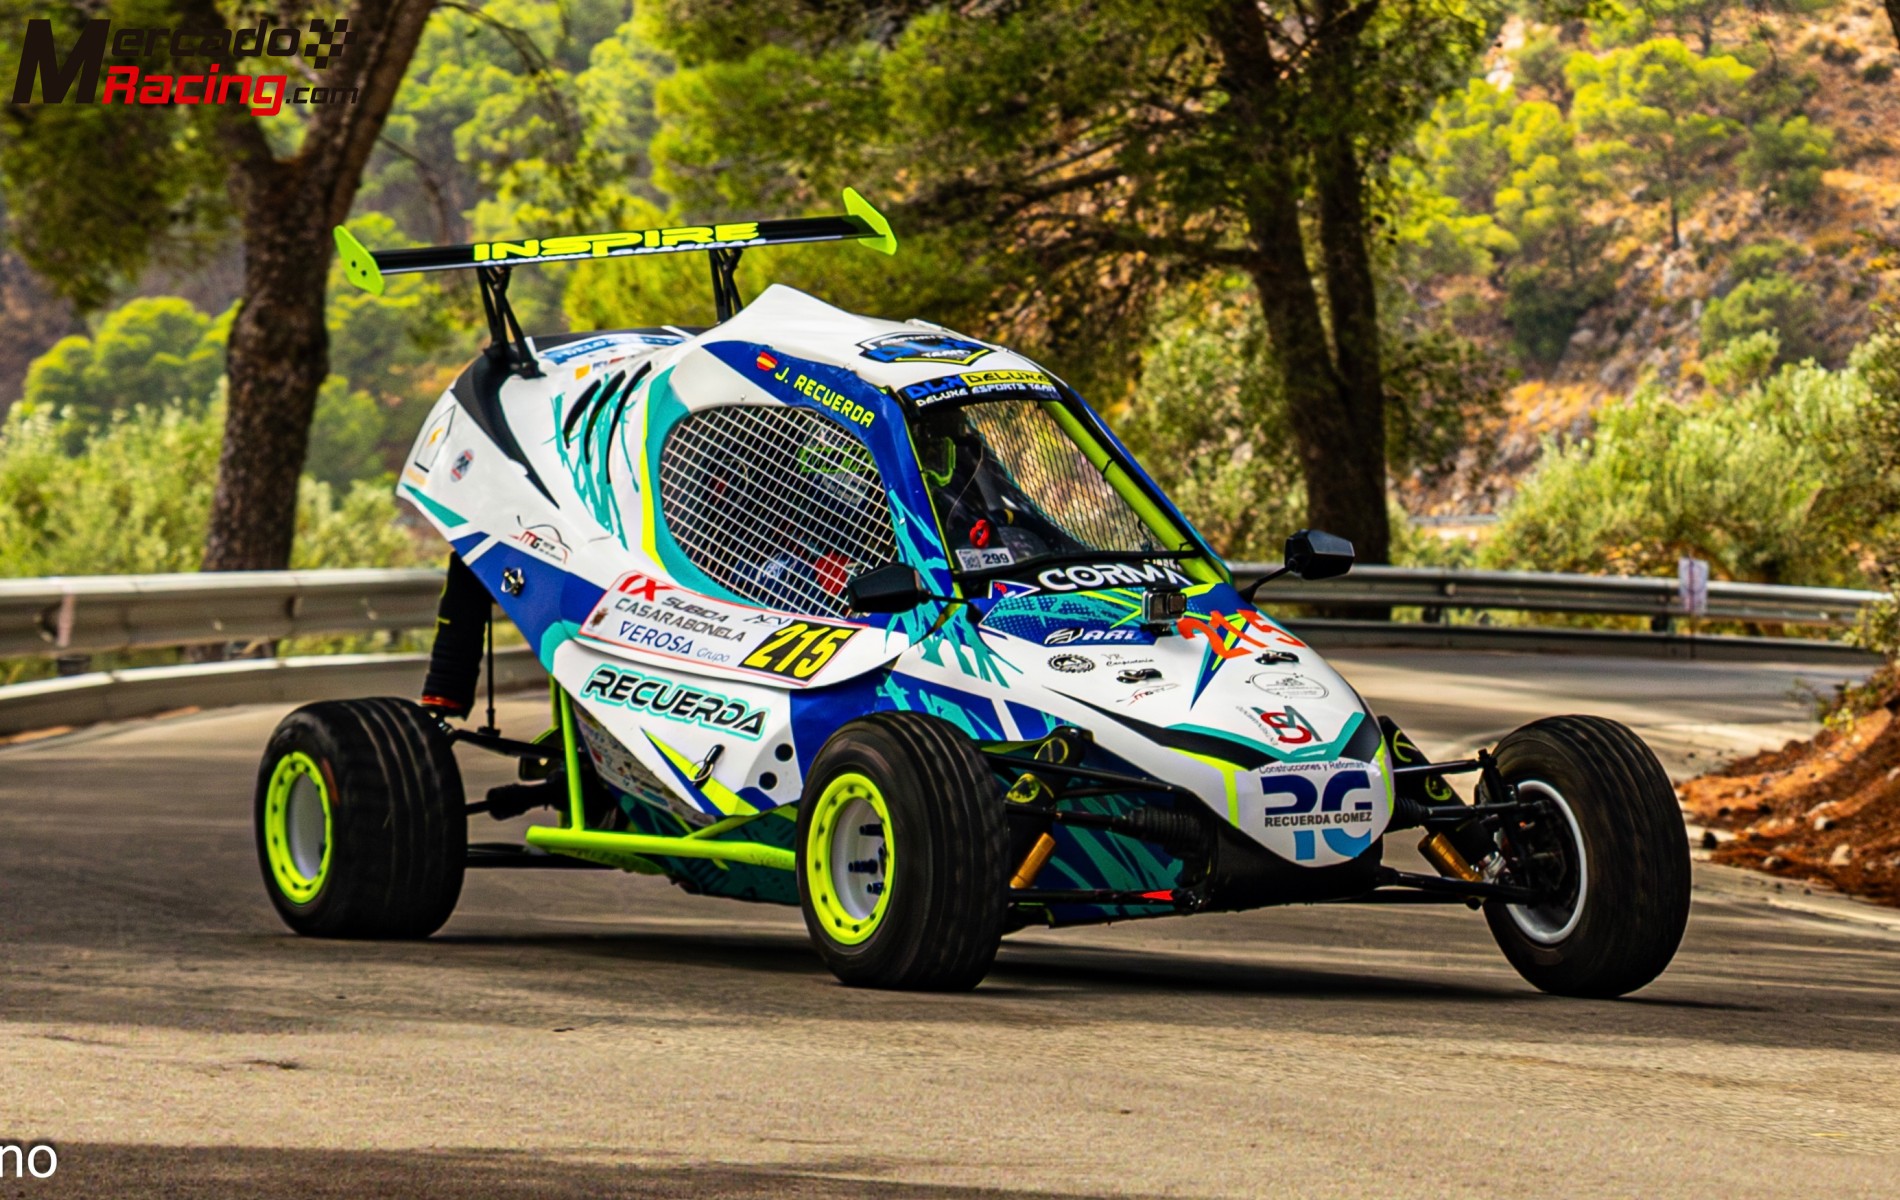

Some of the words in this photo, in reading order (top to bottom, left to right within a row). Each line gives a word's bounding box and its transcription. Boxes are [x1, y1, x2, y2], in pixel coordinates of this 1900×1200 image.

[474, 222, 759, 261] INSPIRE
[775, 366, 789, 384] J.
[794, 374, 876, 428] RECUERDA
[915, 387, 969, 407] DELUXE
[971, 383, 1026, 395] ESPORTS
[982, 553, 1010, 565] 299
[614, 597, 747, 642] CASARABONELA
[661, 596, 730, 624] SUBIDA
[618, 620, 693, 655] VEROSA
[696, 646, 730, 664] Grupo
[743, 623, 855, 678] 215
[1176, 609, 1307, 659] 215
[583, 667, 769, 738] RECUERDA
[1258, 762, 1321, 774] Construcciones
[1265, 814, 1331, 828] RECUERDA
[1334, 811, 1373, 824] GOMEZ
